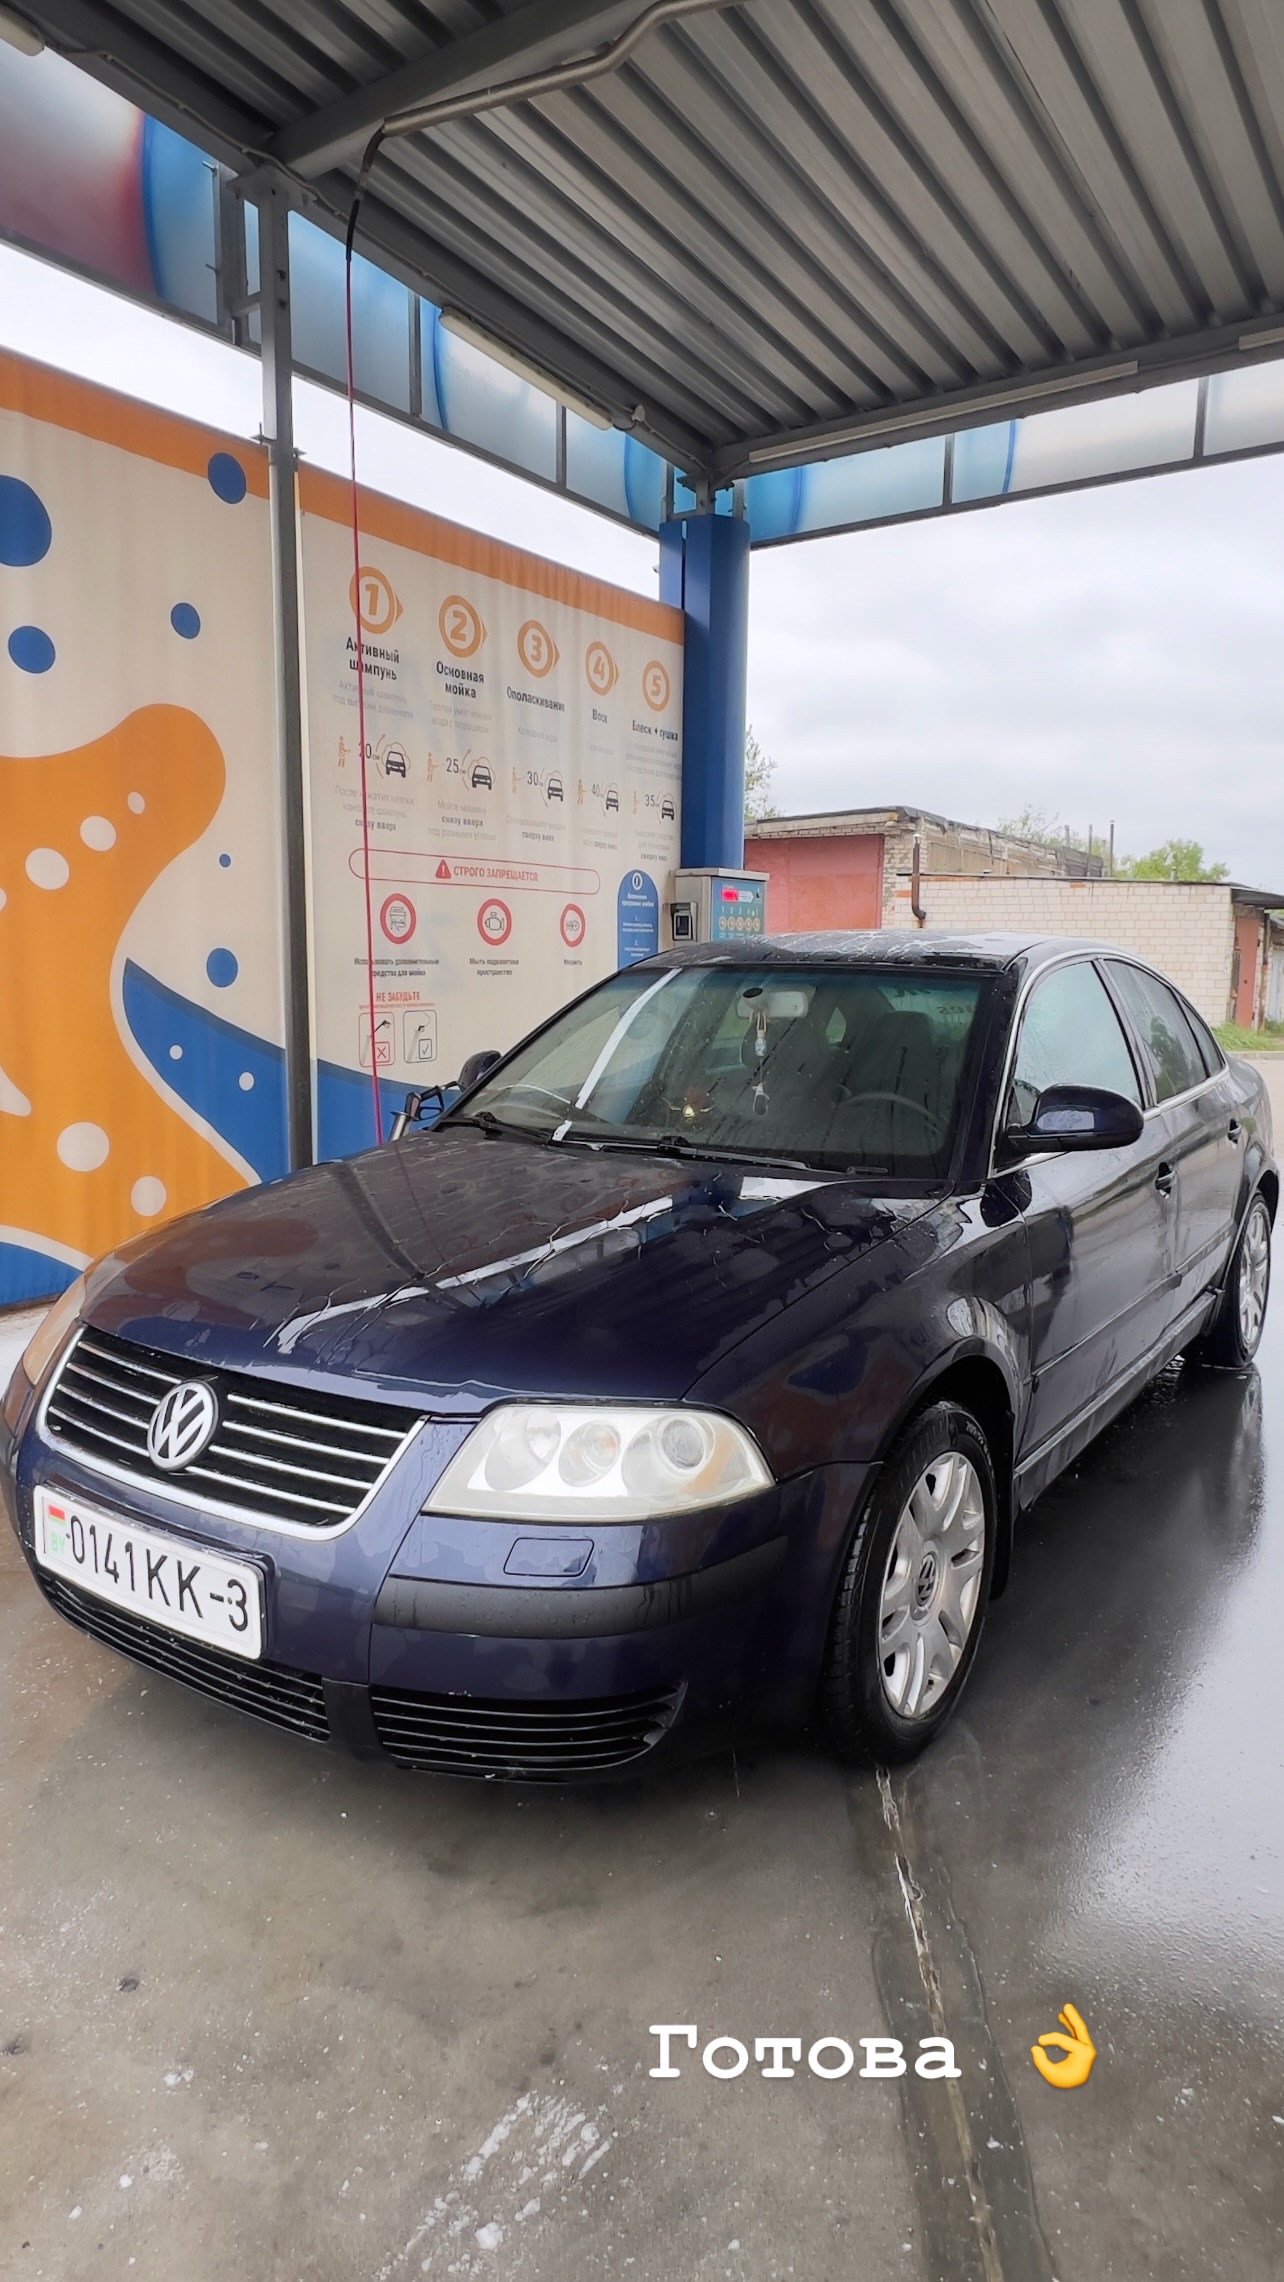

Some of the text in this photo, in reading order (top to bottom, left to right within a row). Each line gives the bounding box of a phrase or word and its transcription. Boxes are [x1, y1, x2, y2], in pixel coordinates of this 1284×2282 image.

[365, 583, 379, 616] 1
[450, 609, 467, 642] 2
[530, 634, 542, 662] 3
[436, 661, 485, 684] Основная
[593, 655, 606, 681] 4
[445, 682, 477, 698] мойка
[651, 674, 662, 697] 5
[358, 743, 372, 759] 0
[446, 757, 459, 774] 25
[527, 770, 539, 786] 30
[453, 865, 485, 877] СТРОГО
[376, 991, 420, 1002] НЕ ЗАБУДЬТЕ
